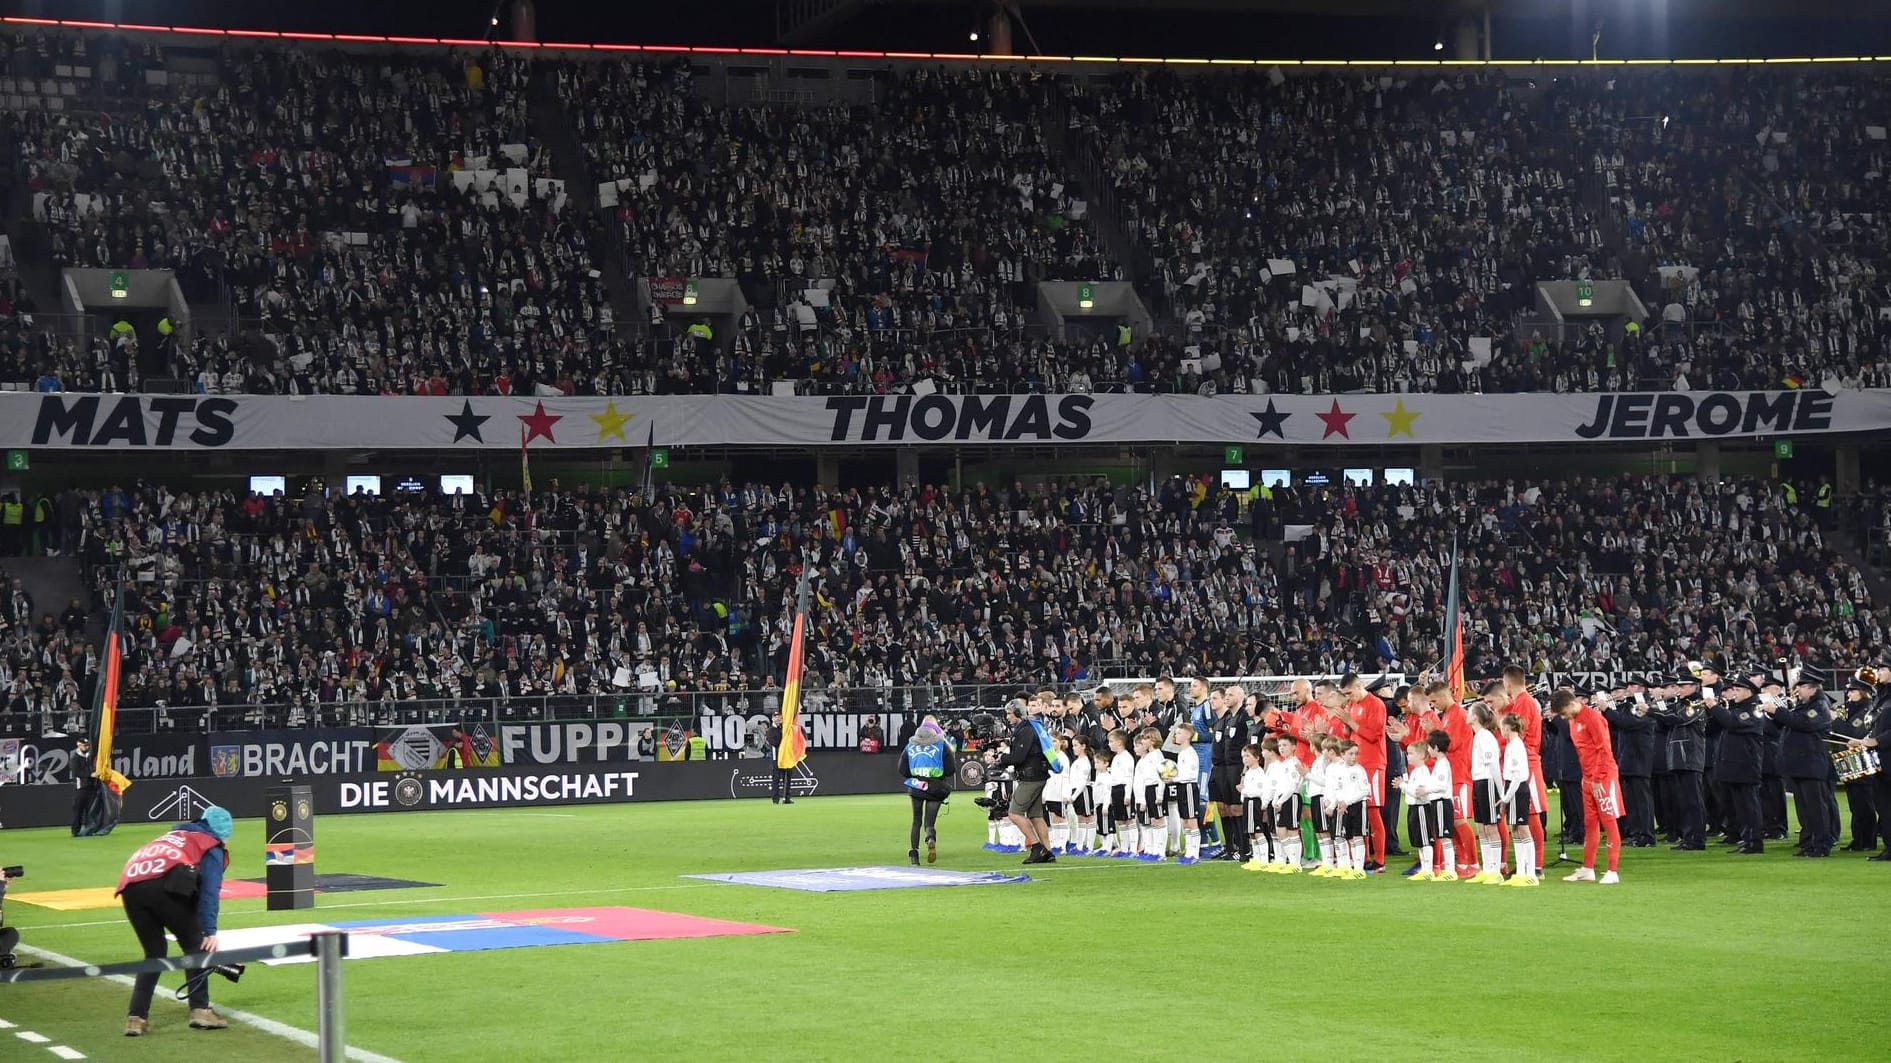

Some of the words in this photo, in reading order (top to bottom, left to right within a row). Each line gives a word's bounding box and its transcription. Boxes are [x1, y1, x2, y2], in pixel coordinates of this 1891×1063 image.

[1579, 286, 1592, 297] 10
[31, 395, 239, 447] MATS
[825, 394, 1095, 441] THOMAS
[1575, 391, 1836, 439] JEROME
[655, 453, 663, 464] 5
[1231, 449, 1239, 460] 7
[244, 741, 370, 777] BRACHT
[341, 782, 389, 808] DIE
[430, 773, 639, 804] MANNSCHAFT
[1168, 785, 1178, 797] 15
[1599, 797, 1613, 812] 22
[127, 859, 166, 878] 002
